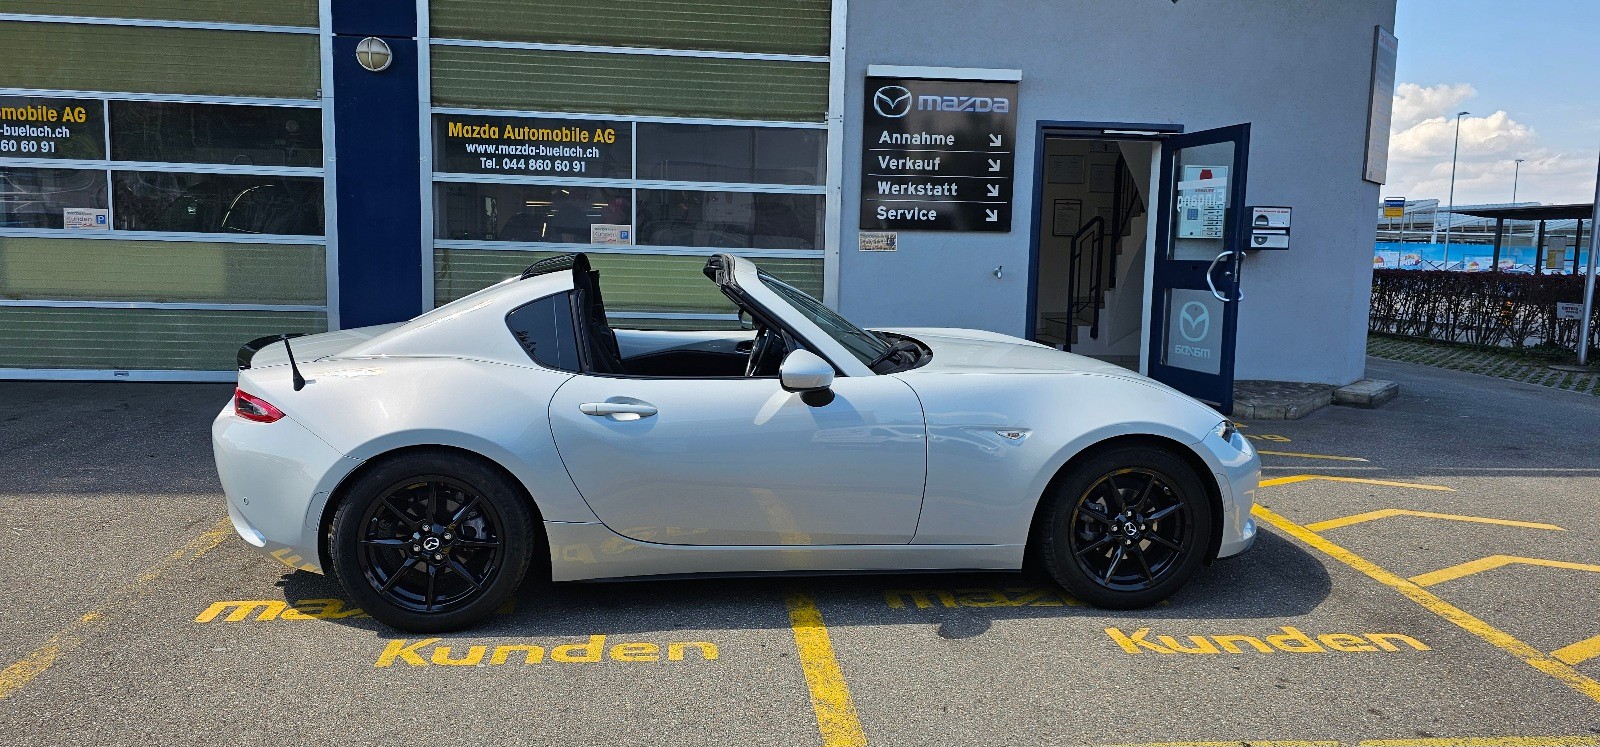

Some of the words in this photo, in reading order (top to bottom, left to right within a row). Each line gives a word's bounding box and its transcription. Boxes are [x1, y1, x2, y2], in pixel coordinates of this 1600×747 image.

[917, 94, 1009, 113] mazda
[0, 105, 58, 122] mobile
[62, 106, 86, 123] AG
[448, 121, 499, 139] Mazda
[503, 124, 589, 143] Automobile
[592, 128, 616, 144] AG
[879, 131, 955, 146] Annahme
[20, 140, 38, 153] 60
[40, 141, 55, 153] 91
[465, 142, 600, 159] www.mazda-buelach.ch
[480, 158, 500, 170] Tel.
[502, 158, 526, 171] 044
[528, 158, 553, 172] 860
[554, 159, 571, 172] 60
[573, 159, 587, 173] 91
[878, 156, 941, 171] Verkauf
[877, 181, 958, 196] Werkstatt
[876, 206, 937, 221] Service
[1104, 625, 1432, 655] Kunden
[374, 634, 719, 668] Kunden
